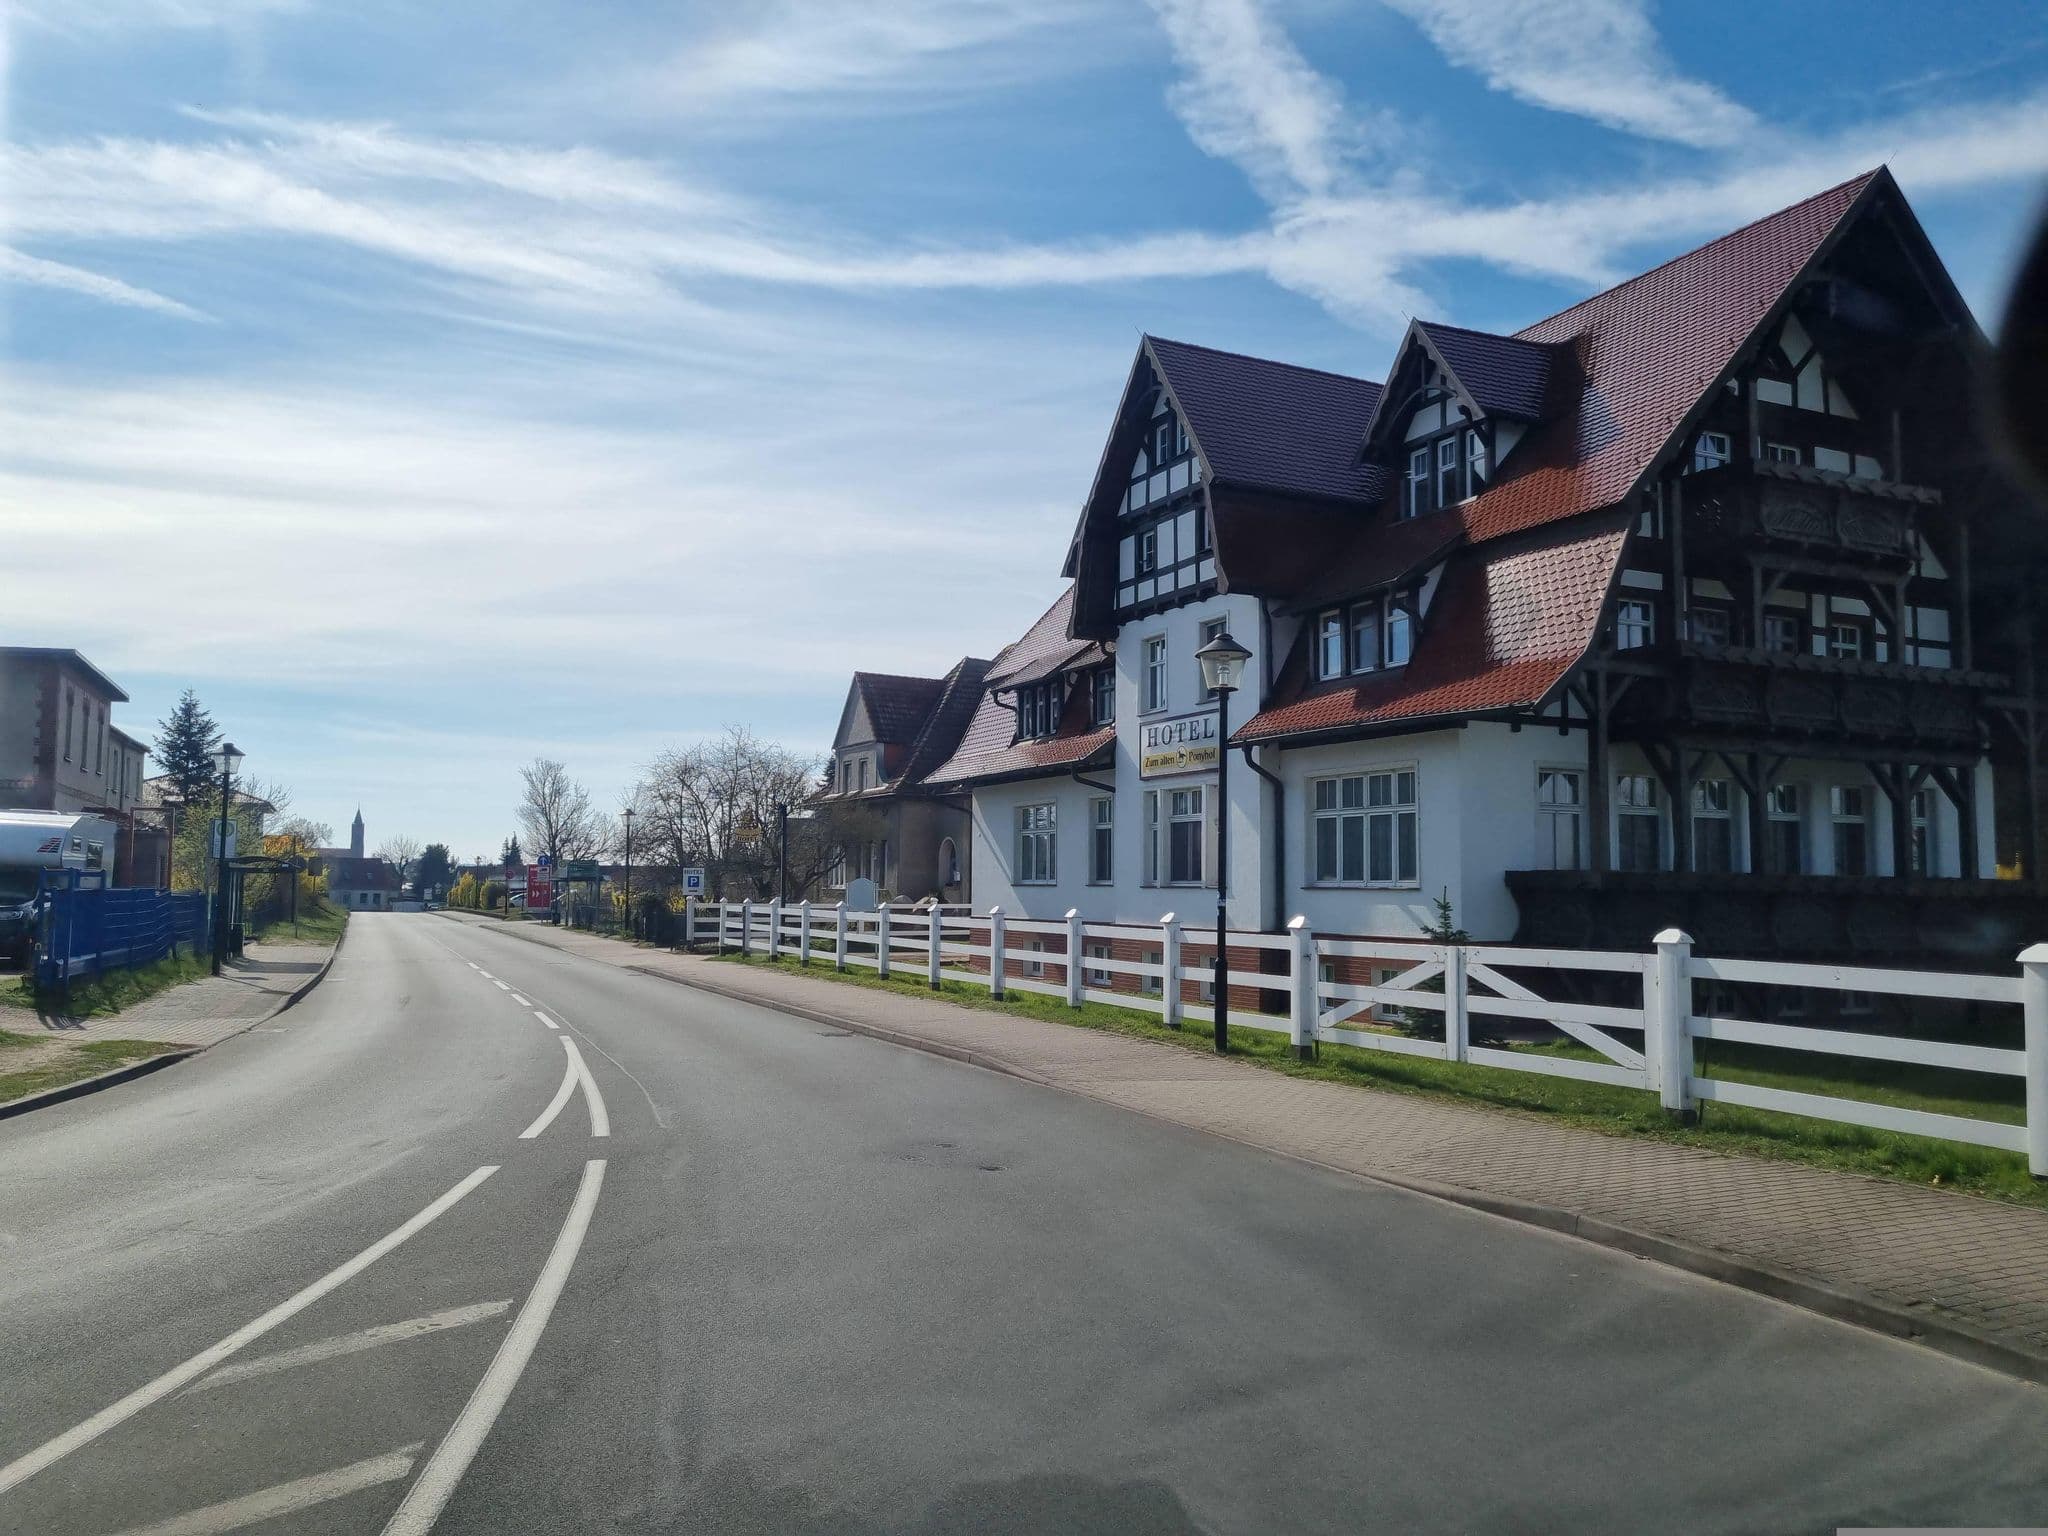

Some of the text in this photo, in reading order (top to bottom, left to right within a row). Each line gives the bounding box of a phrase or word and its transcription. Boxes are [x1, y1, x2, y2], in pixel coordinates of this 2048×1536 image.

[1147, 718, 1214, 747] HOTEL
[1145, 748, 1216, 767] Zum alten Ponyhof
[690, 877, 698, 886] P
